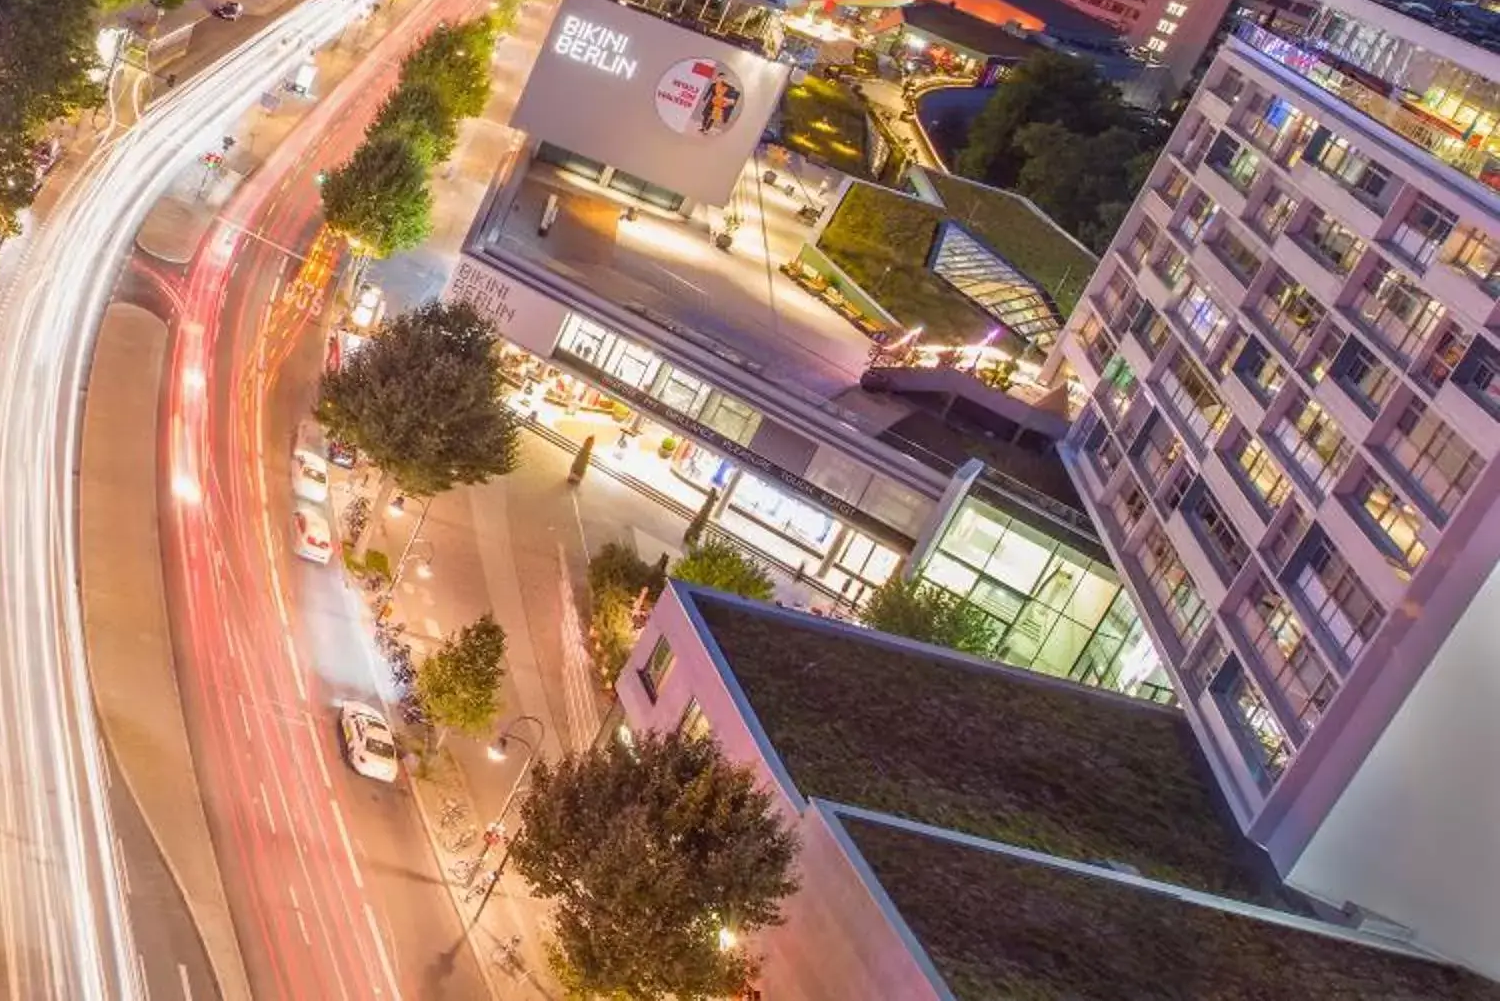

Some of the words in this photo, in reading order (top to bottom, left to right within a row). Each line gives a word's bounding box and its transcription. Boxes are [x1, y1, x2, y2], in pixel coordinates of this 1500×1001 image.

[564, 15, 629, 54] BIKINI
[555, 34, 638, 80] BERLIN
[452, 278, 516, 323] BERLIN
[460, 263, 510, 299] BIKINI
